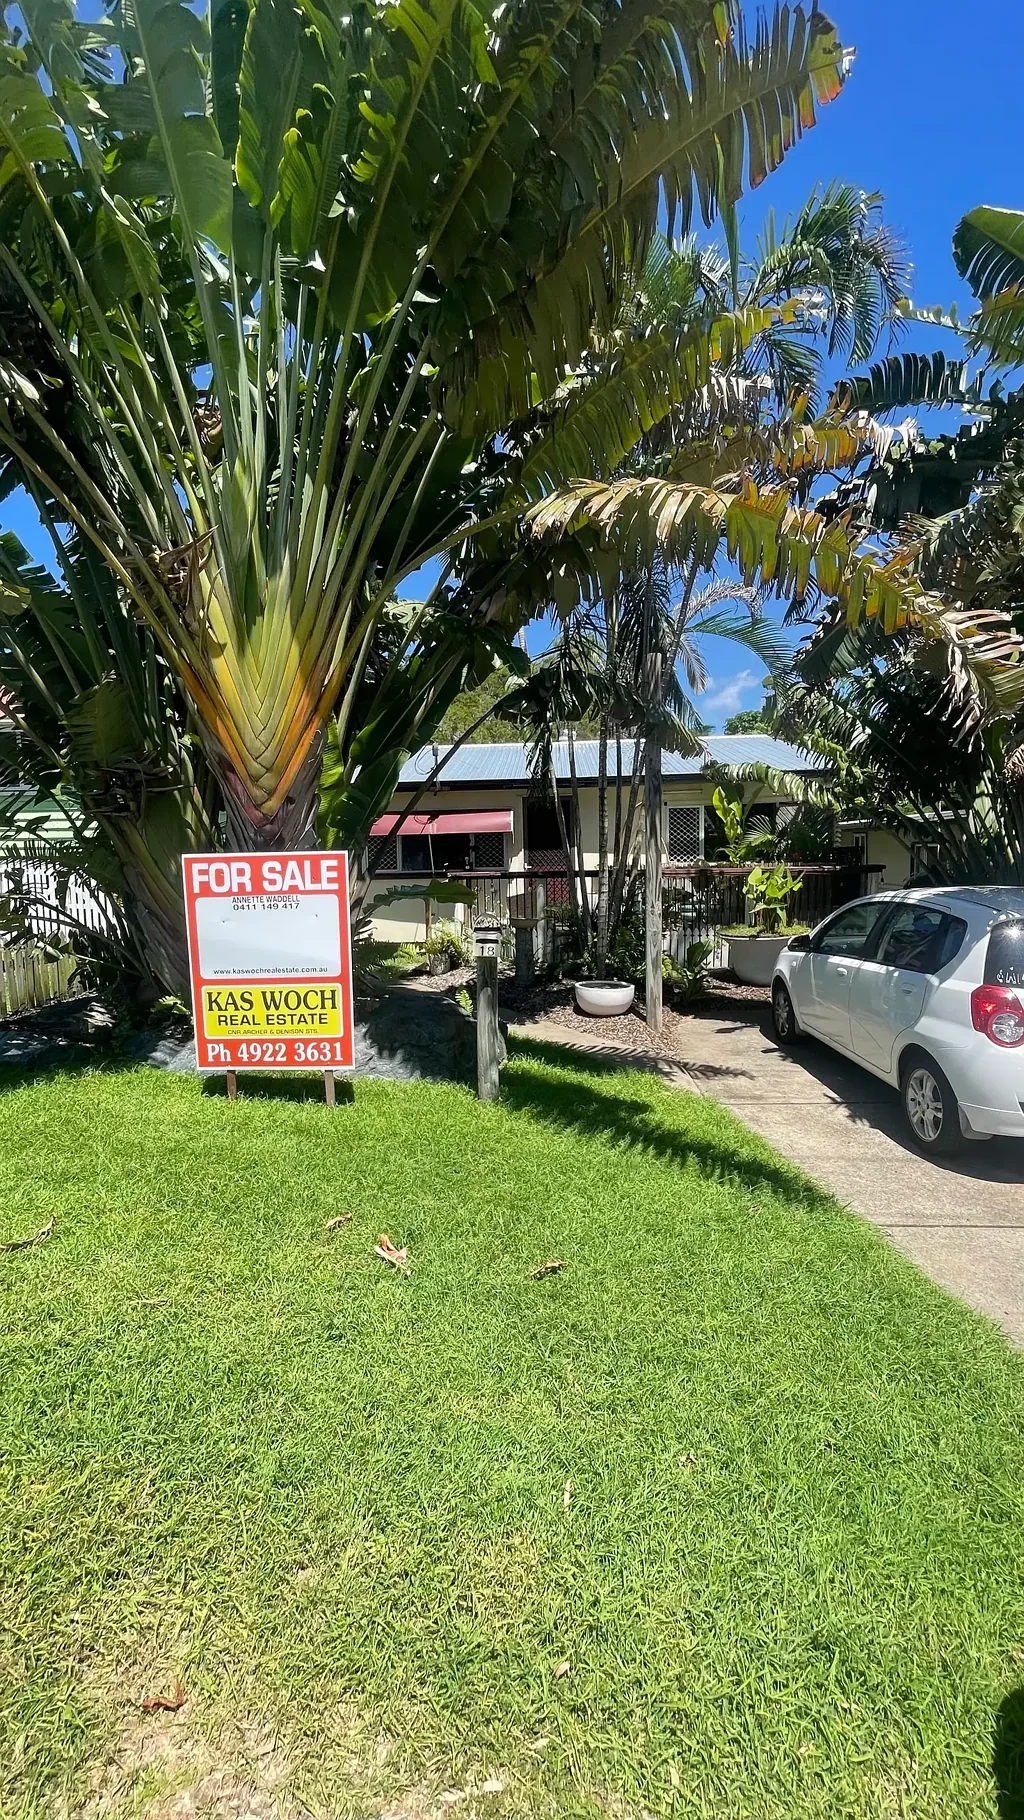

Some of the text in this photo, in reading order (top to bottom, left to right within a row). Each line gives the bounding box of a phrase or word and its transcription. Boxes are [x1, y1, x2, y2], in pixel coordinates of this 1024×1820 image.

[191, 859, 339, 894] FOR SALE
[232, 895, 300, 904] ANNETTE WADDELL
[480, 946, 495, 956] 18
[213, 966, 328, 975] www.kaswochrealestate.com.au
[206, 989, 338, 1012] KAS WOCH
[217, 1013, 328, 1026] REAL ESTATE
[206, 1041, 343, 1062] Ph 4922 3631
